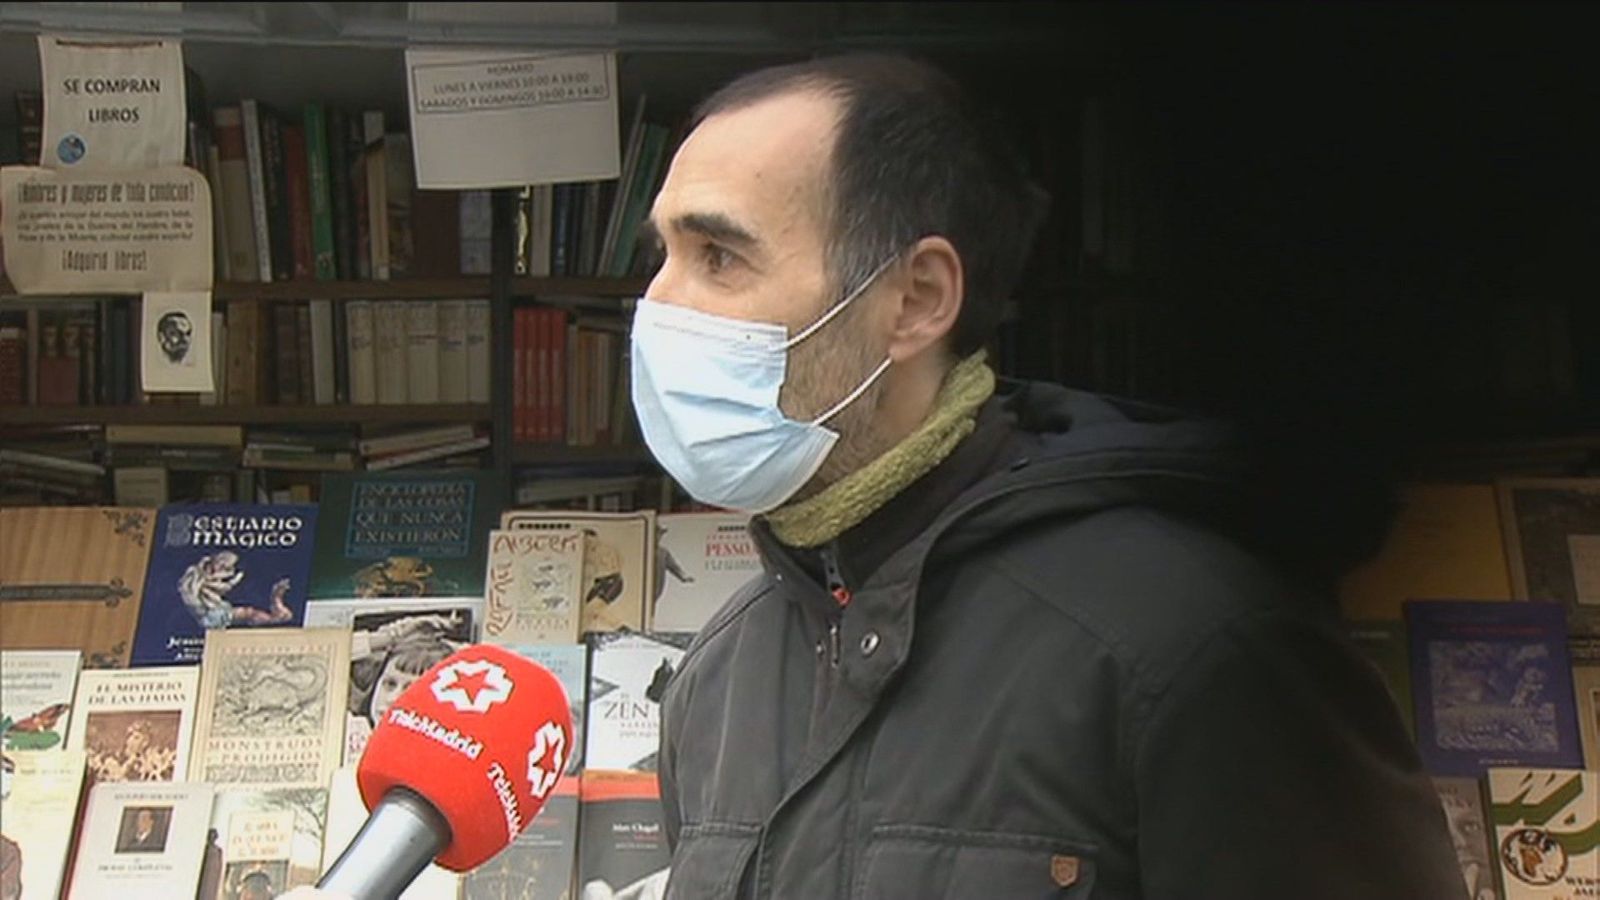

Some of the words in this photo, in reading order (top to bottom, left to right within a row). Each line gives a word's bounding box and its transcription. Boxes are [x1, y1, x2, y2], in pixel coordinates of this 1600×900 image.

[63, 78, 80, 94] SE
[84, 78, 161, 95] COMPRAN
[479, 76, 521, 92] VIERNES
[88, 107, 141, 124] LIBROS
[71, 184, 108, 205] mujeres
[110, 183, 124, 203] de
[355, 511, 389, 528] QUE
[400, 511, 463, 524] NUNCA
[117, 681, 182, 693] MISTERIO
[88, 695, 105, 705] DE
[111, 694, 135, 705] LAS
[140, 693, 187, 704] HADAS
[604, 701, 650, 720] ZEN
[207, 738, 323, 751] MONSTRUOS
[221, 751, 322, 764] PRODIGIOS
